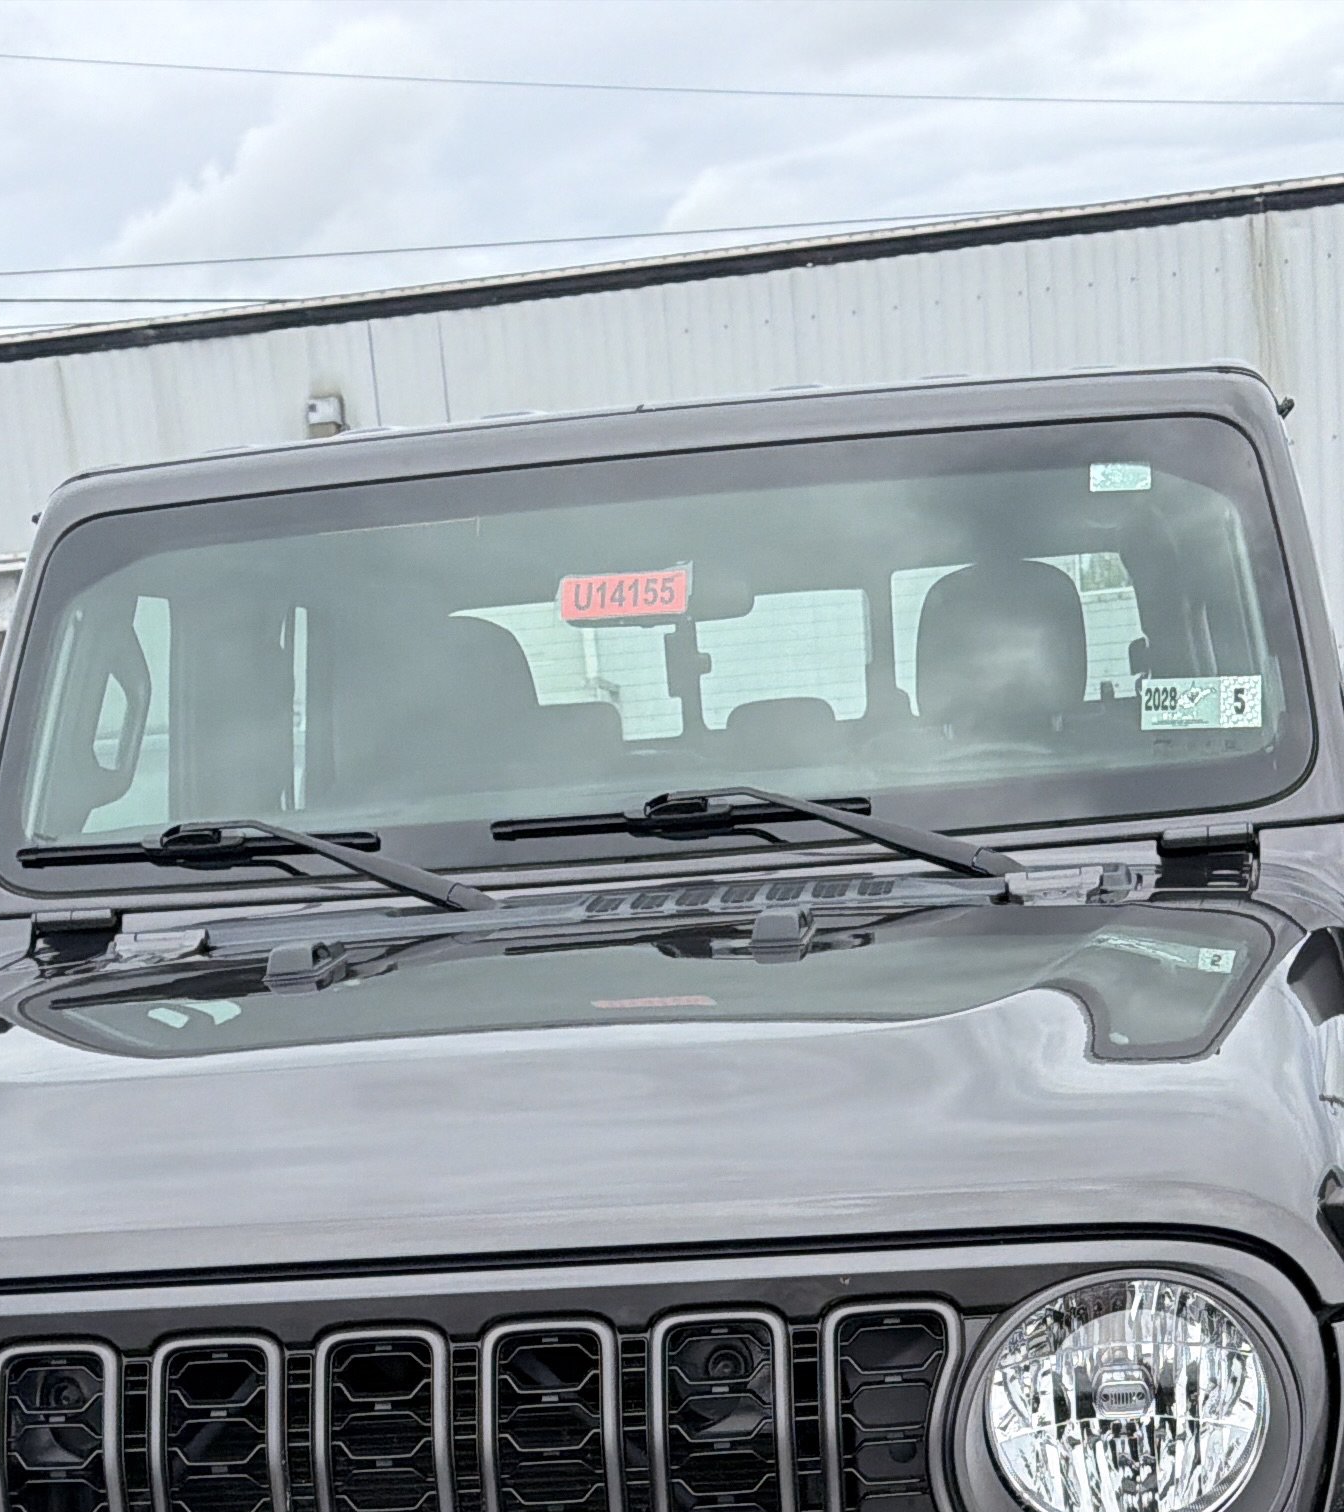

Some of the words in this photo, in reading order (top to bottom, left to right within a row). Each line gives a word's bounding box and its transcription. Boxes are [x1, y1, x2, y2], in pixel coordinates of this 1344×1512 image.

[574, 577, 675, 611] U14155
[1144, 686, 1178, 712] 2028
[1233, 688, 1246, 715] 5
